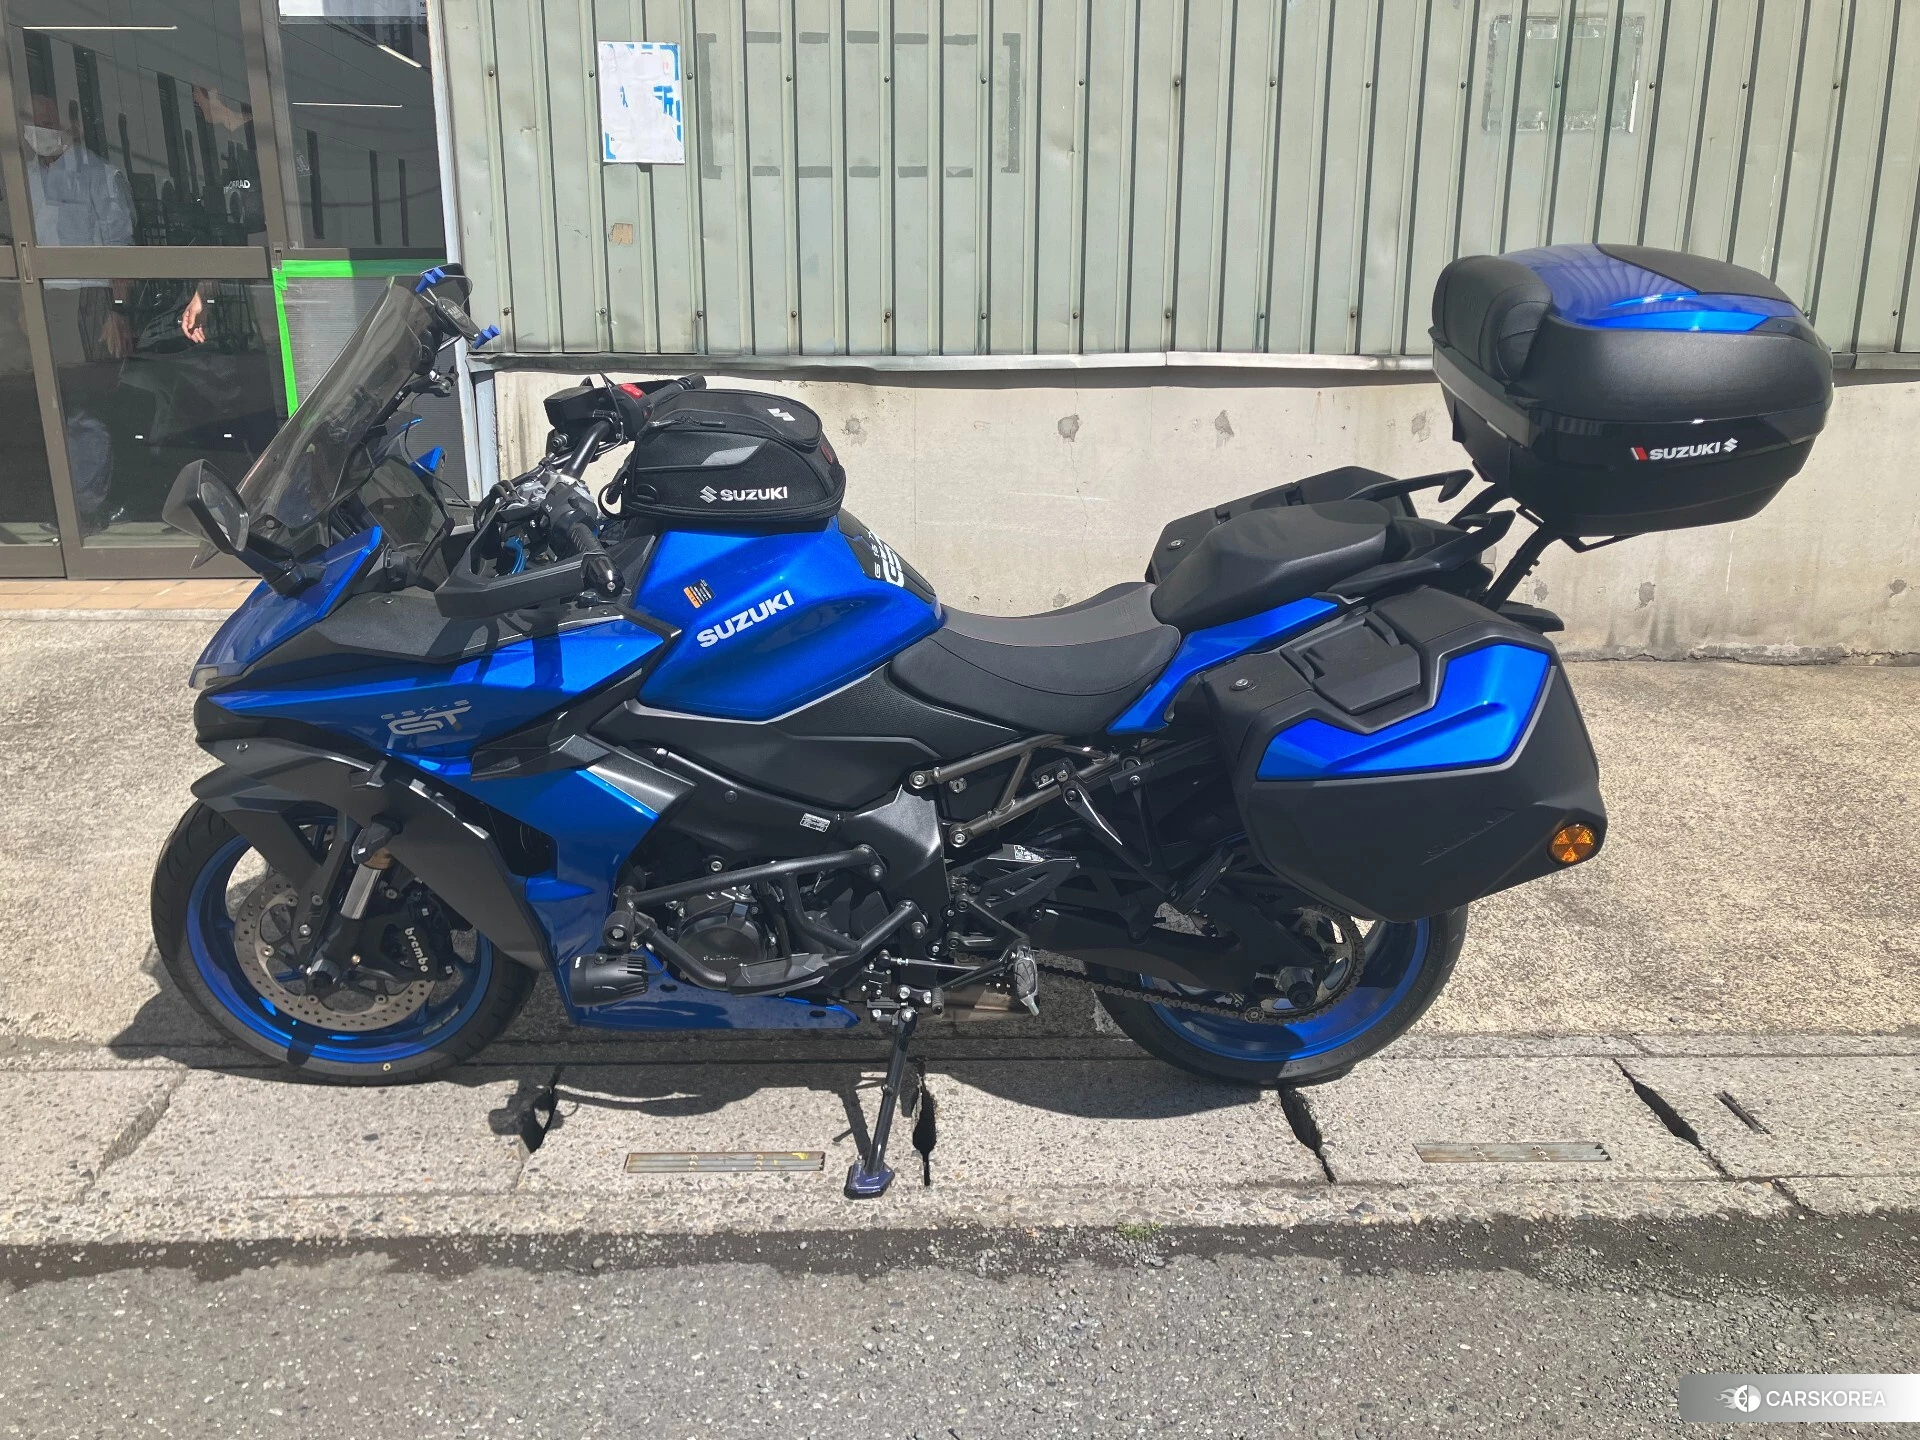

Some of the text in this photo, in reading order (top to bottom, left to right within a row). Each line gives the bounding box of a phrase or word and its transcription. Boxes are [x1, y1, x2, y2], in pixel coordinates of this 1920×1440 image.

[1649, 441, 1721, 461] SUZUKI
[719, 486, 788, 502] SUZUKI
[696, 589, 795, 648] SUZUKI
[387, 705, 473, 736] GT
[404, 926, 429, 973] brembo
